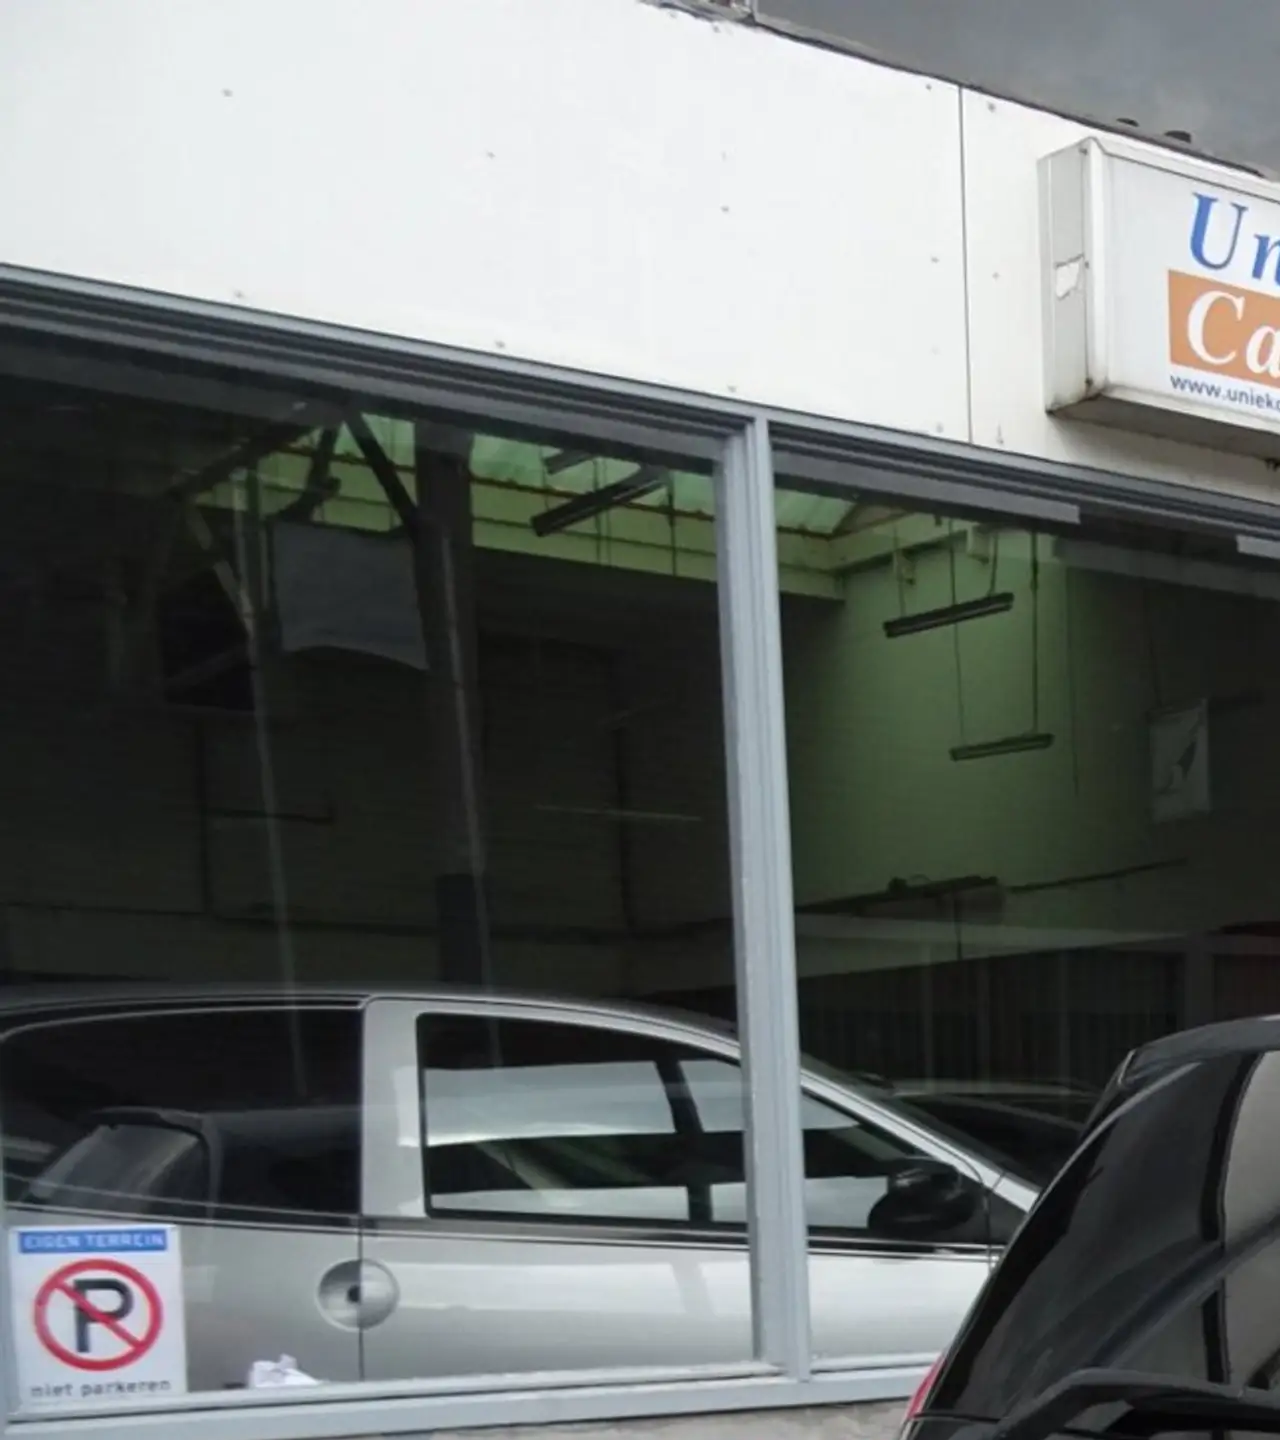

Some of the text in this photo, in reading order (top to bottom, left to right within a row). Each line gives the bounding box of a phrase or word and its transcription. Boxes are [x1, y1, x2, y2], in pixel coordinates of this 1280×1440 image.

[23, 1231, 166, 1249] EIGEN TERREIN
[30, 1379, 172, 1398] niet parkeren
